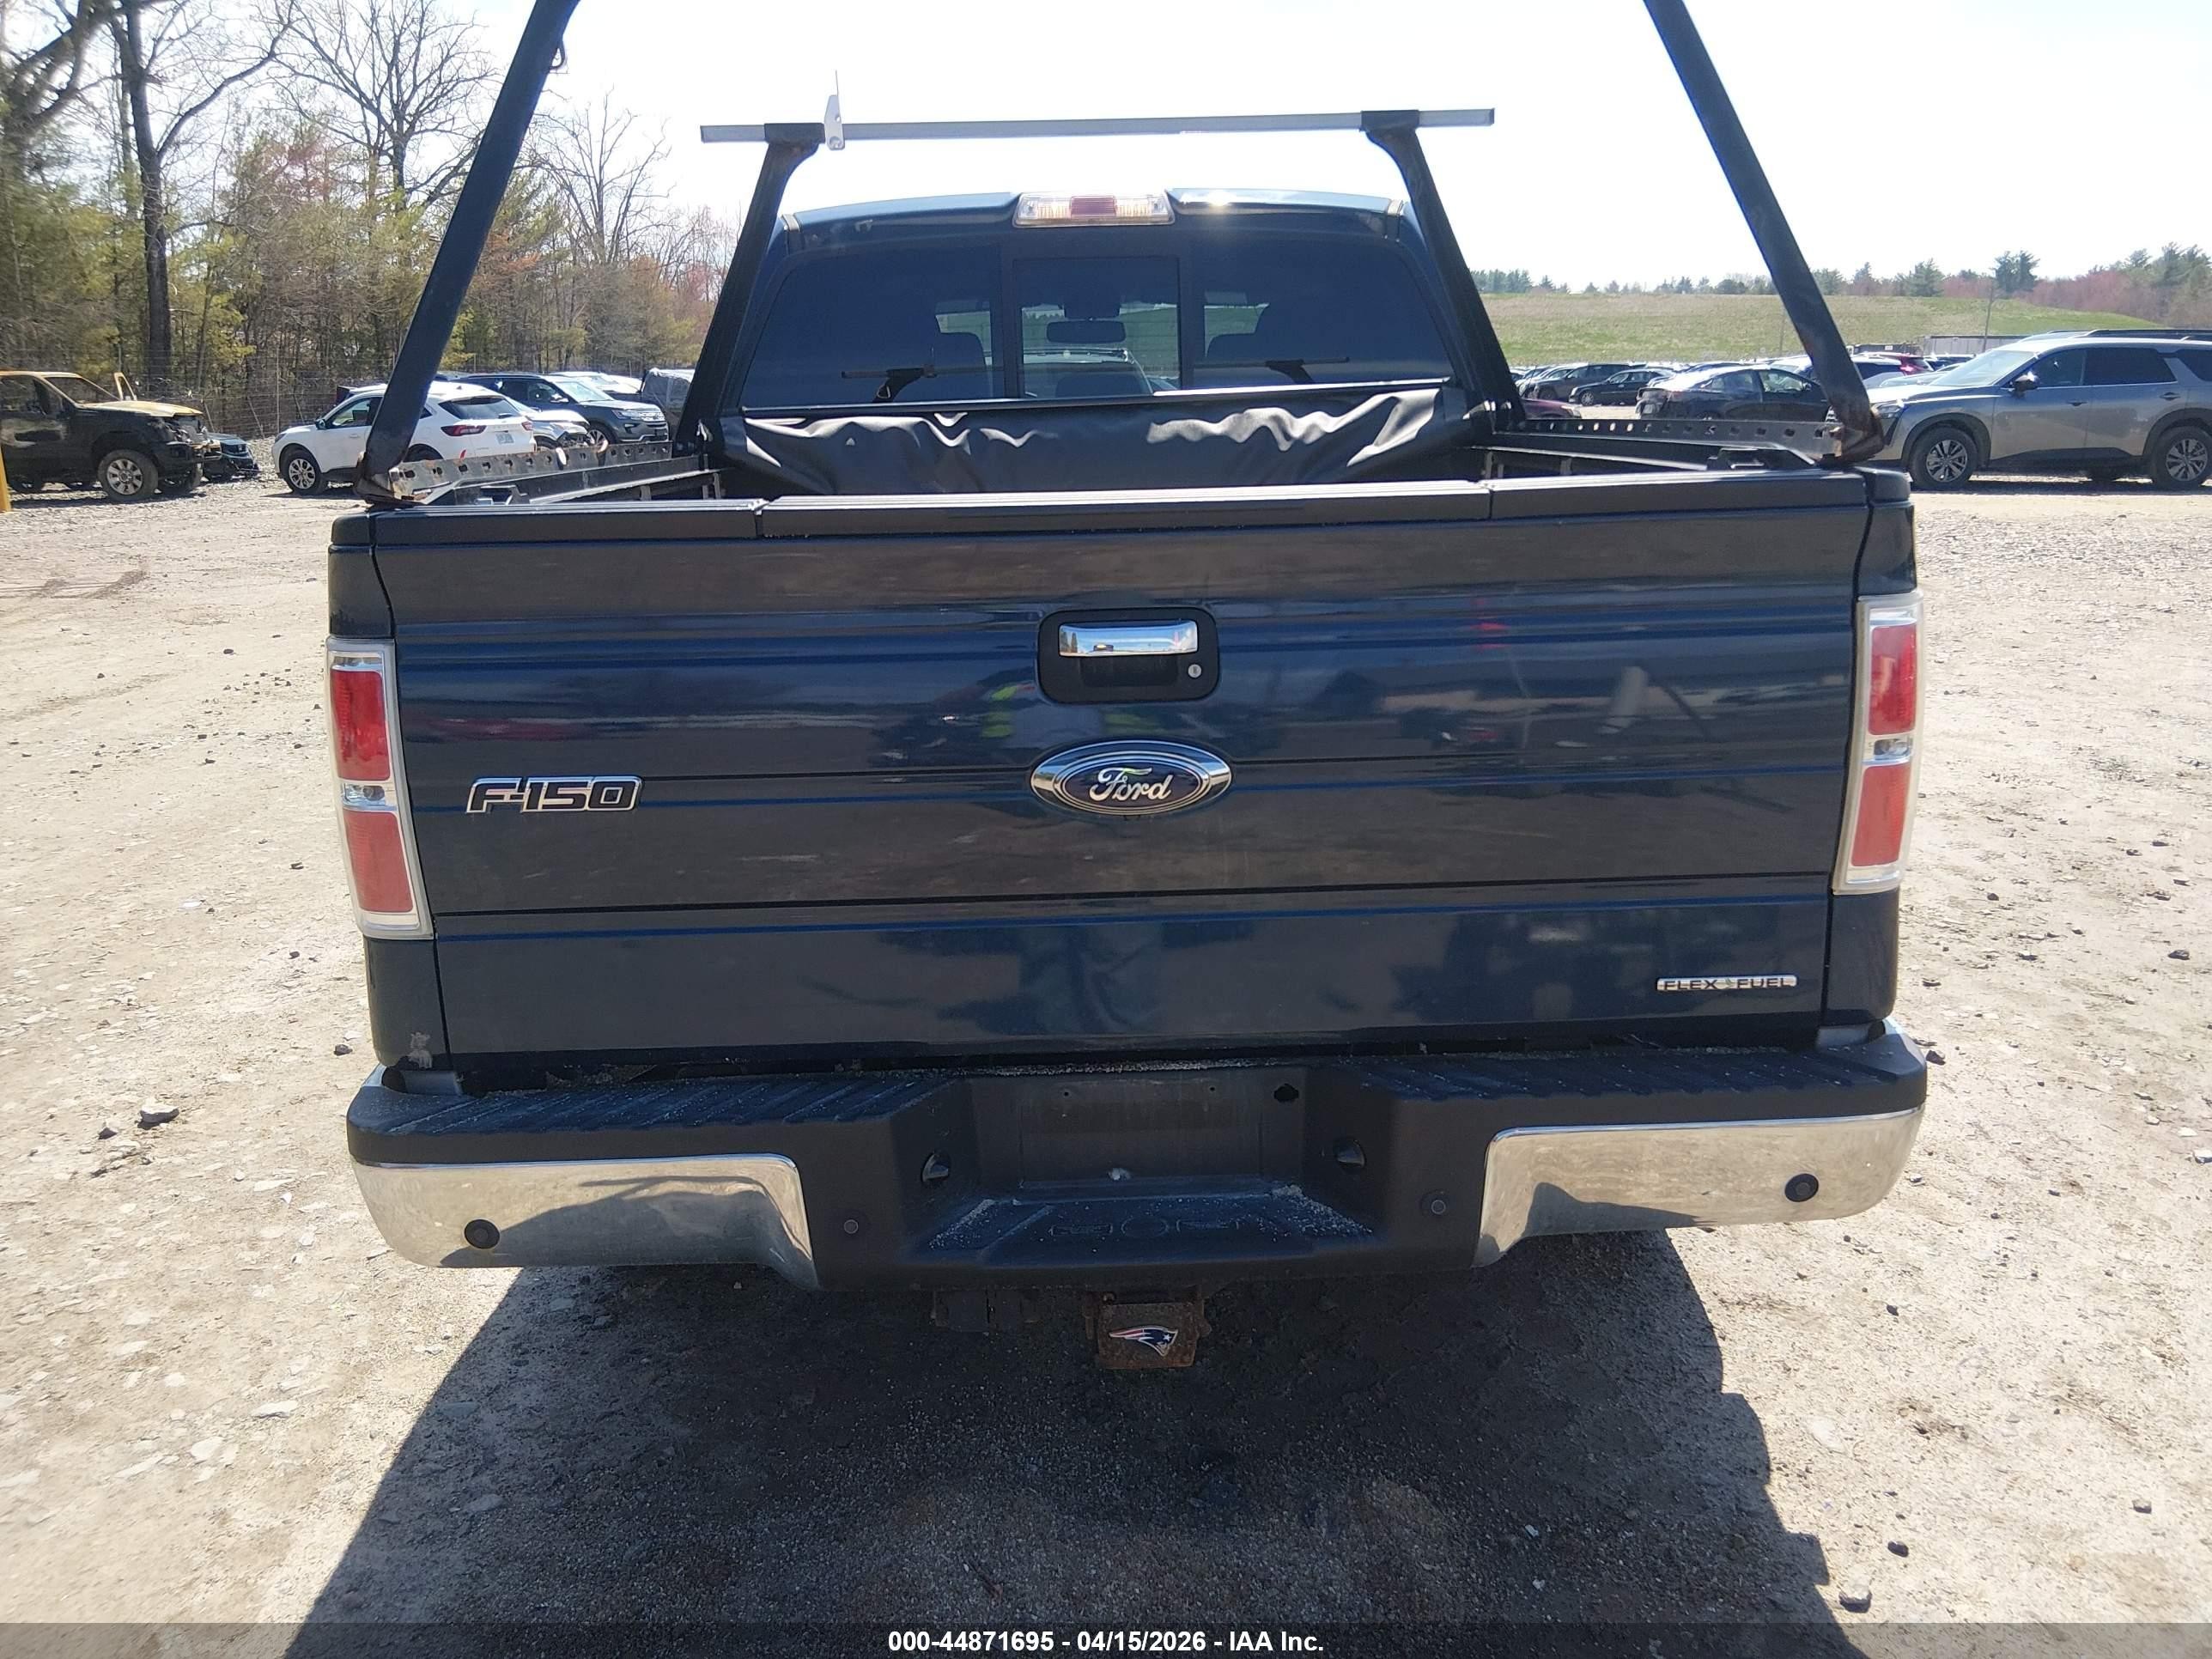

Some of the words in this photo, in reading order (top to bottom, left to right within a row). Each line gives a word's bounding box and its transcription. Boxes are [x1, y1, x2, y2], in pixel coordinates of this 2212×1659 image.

[465, 775, 642, 813] F-150
[1089, 767, 1171, 801] Ford
[1663, 979, 1718, 991] FLEX
[1736, 976, 1792, 989] FUEL
